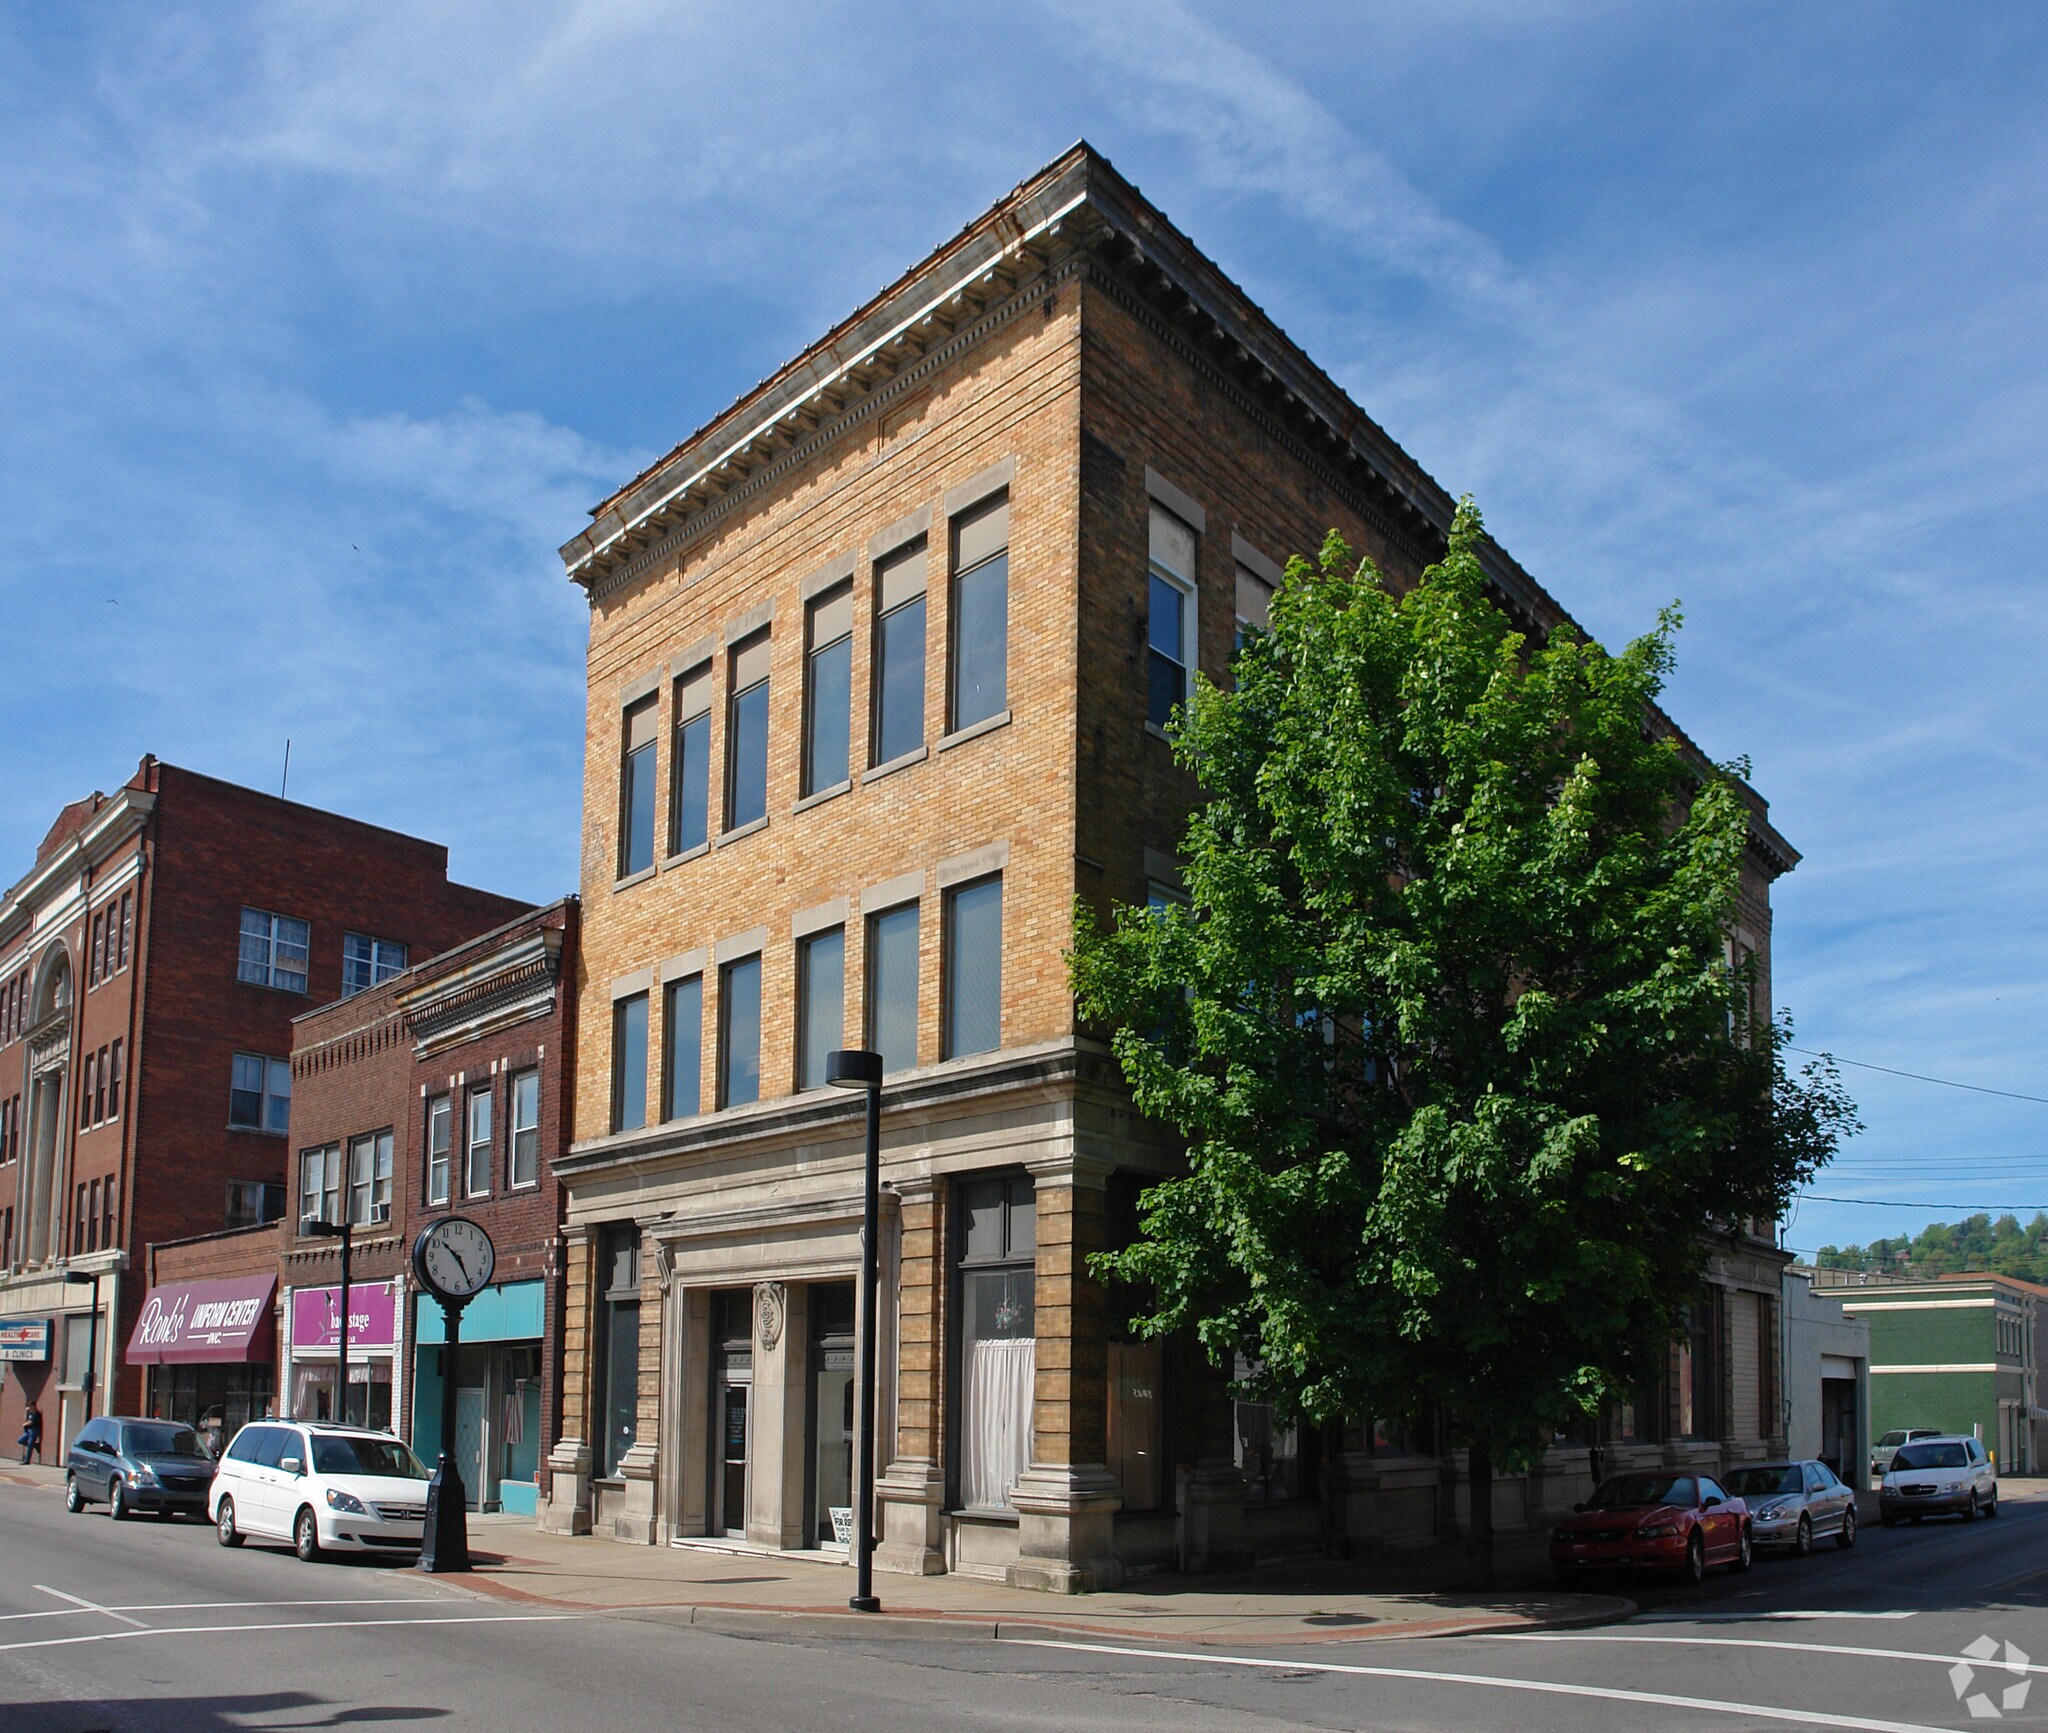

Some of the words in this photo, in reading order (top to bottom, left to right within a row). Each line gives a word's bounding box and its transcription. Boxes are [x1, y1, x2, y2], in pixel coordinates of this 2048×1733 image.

[443, 1228, 449, 1239] 11
[454, 1224, 463, 1235] 12
[432, 1238, 440, 1249] 10
[478, 1240, 483, 1251] 2
[428, 1251, 434, 1262] 9
[481, 1254, 487, 1265] 3
[432, 1264, 438, 1275] 8
[477, 1267, 482, 1277] 4
[441, 1276, 446, 1287] 7
[454, 1280, 460, 1291] 6
[189, 1301, 230, 1329] UNIFORM
[222, 1298, 261, 1328] CENTER
[1, 1331, 21, 1339] HEALTH
[26, 1331, 40, 1339] CARE
[206, 1332, 222, 1345] INC.
[12, 1350, 33, 1359] CLINICS
